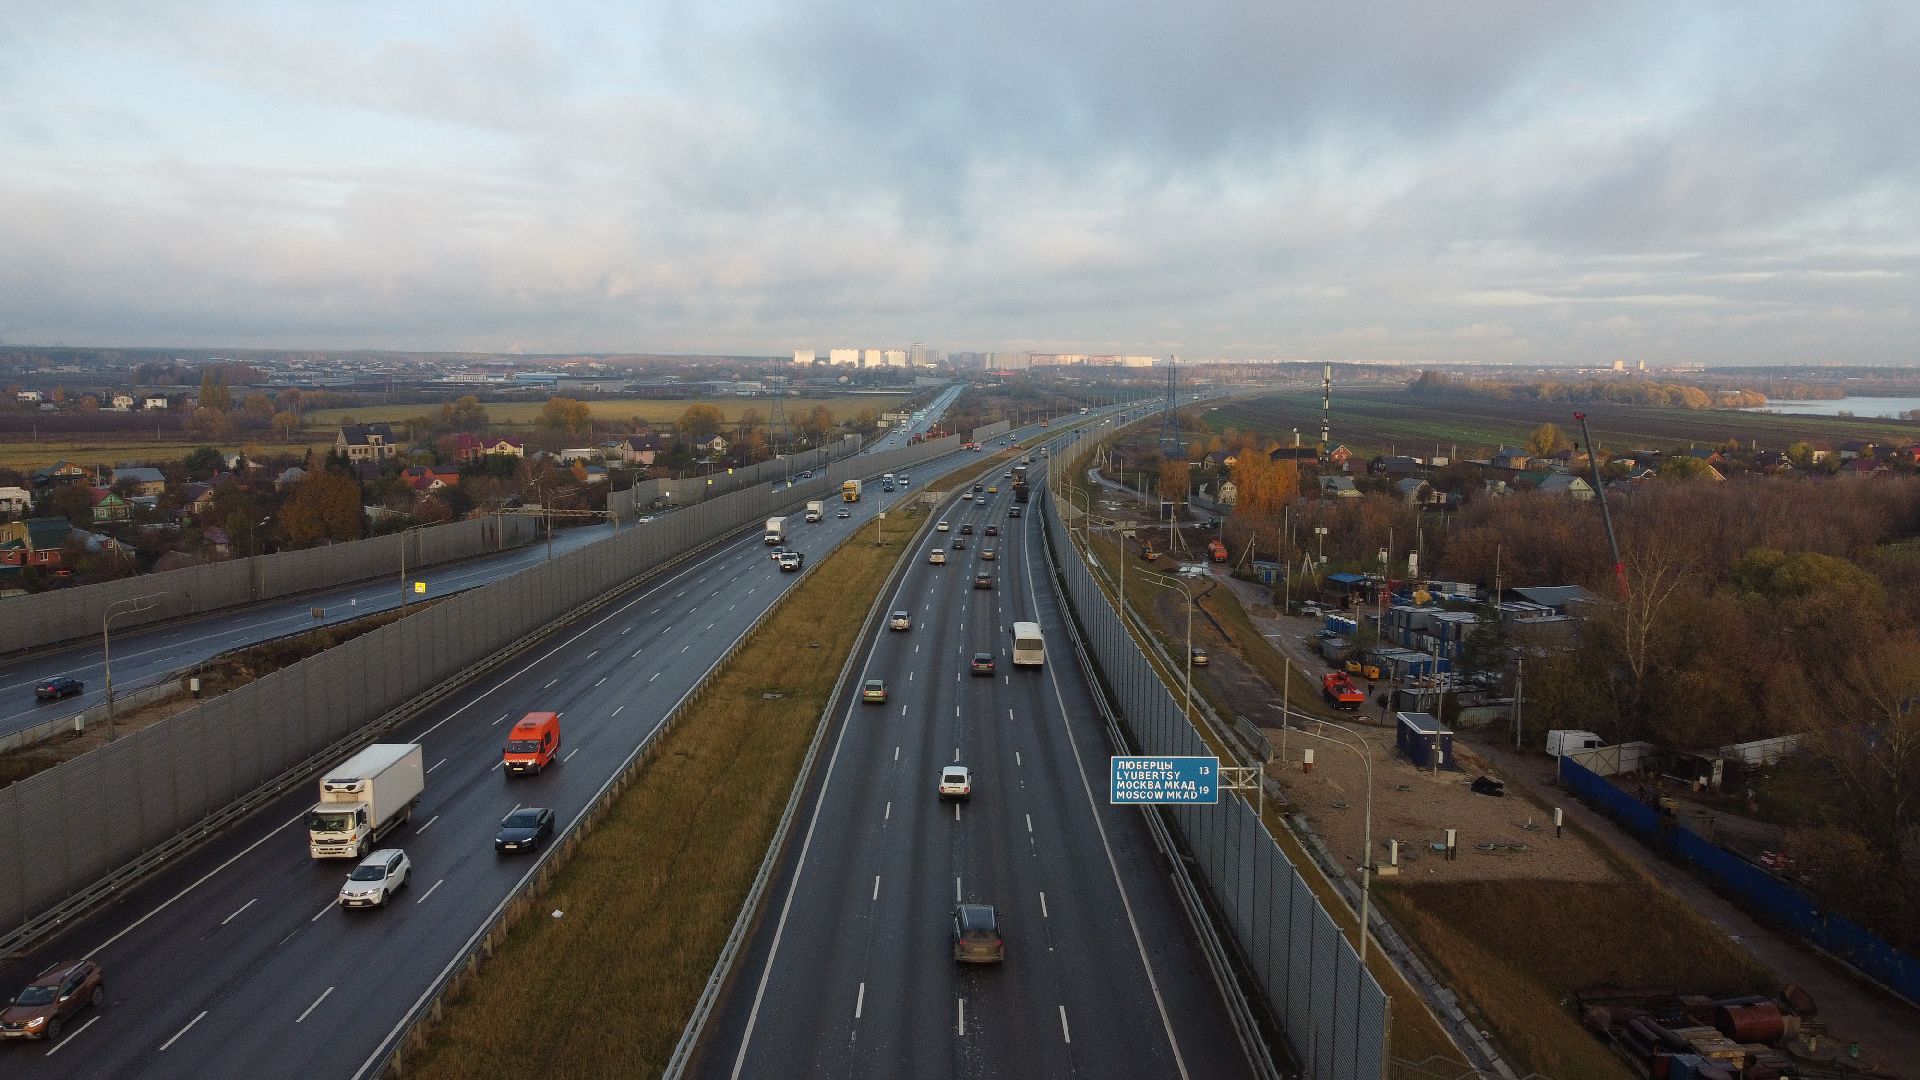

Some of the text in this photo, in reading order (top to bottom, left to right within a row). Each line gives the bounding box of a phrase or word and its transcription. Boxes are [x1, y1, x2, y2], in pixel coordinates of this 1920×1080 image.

[1117, 761, 1173, 770] ЛЮБЕРЦЫ
[1199, 766, 1210, 775] 13
[1116, 771, 1180, 780] LYUBERTSY
[1116, 781, 1196, 790] МОСКВА МКАД
[1199, 786, 1210, 794] 19
[1116, 790, 1198, 799] MOSCOW MKAD
